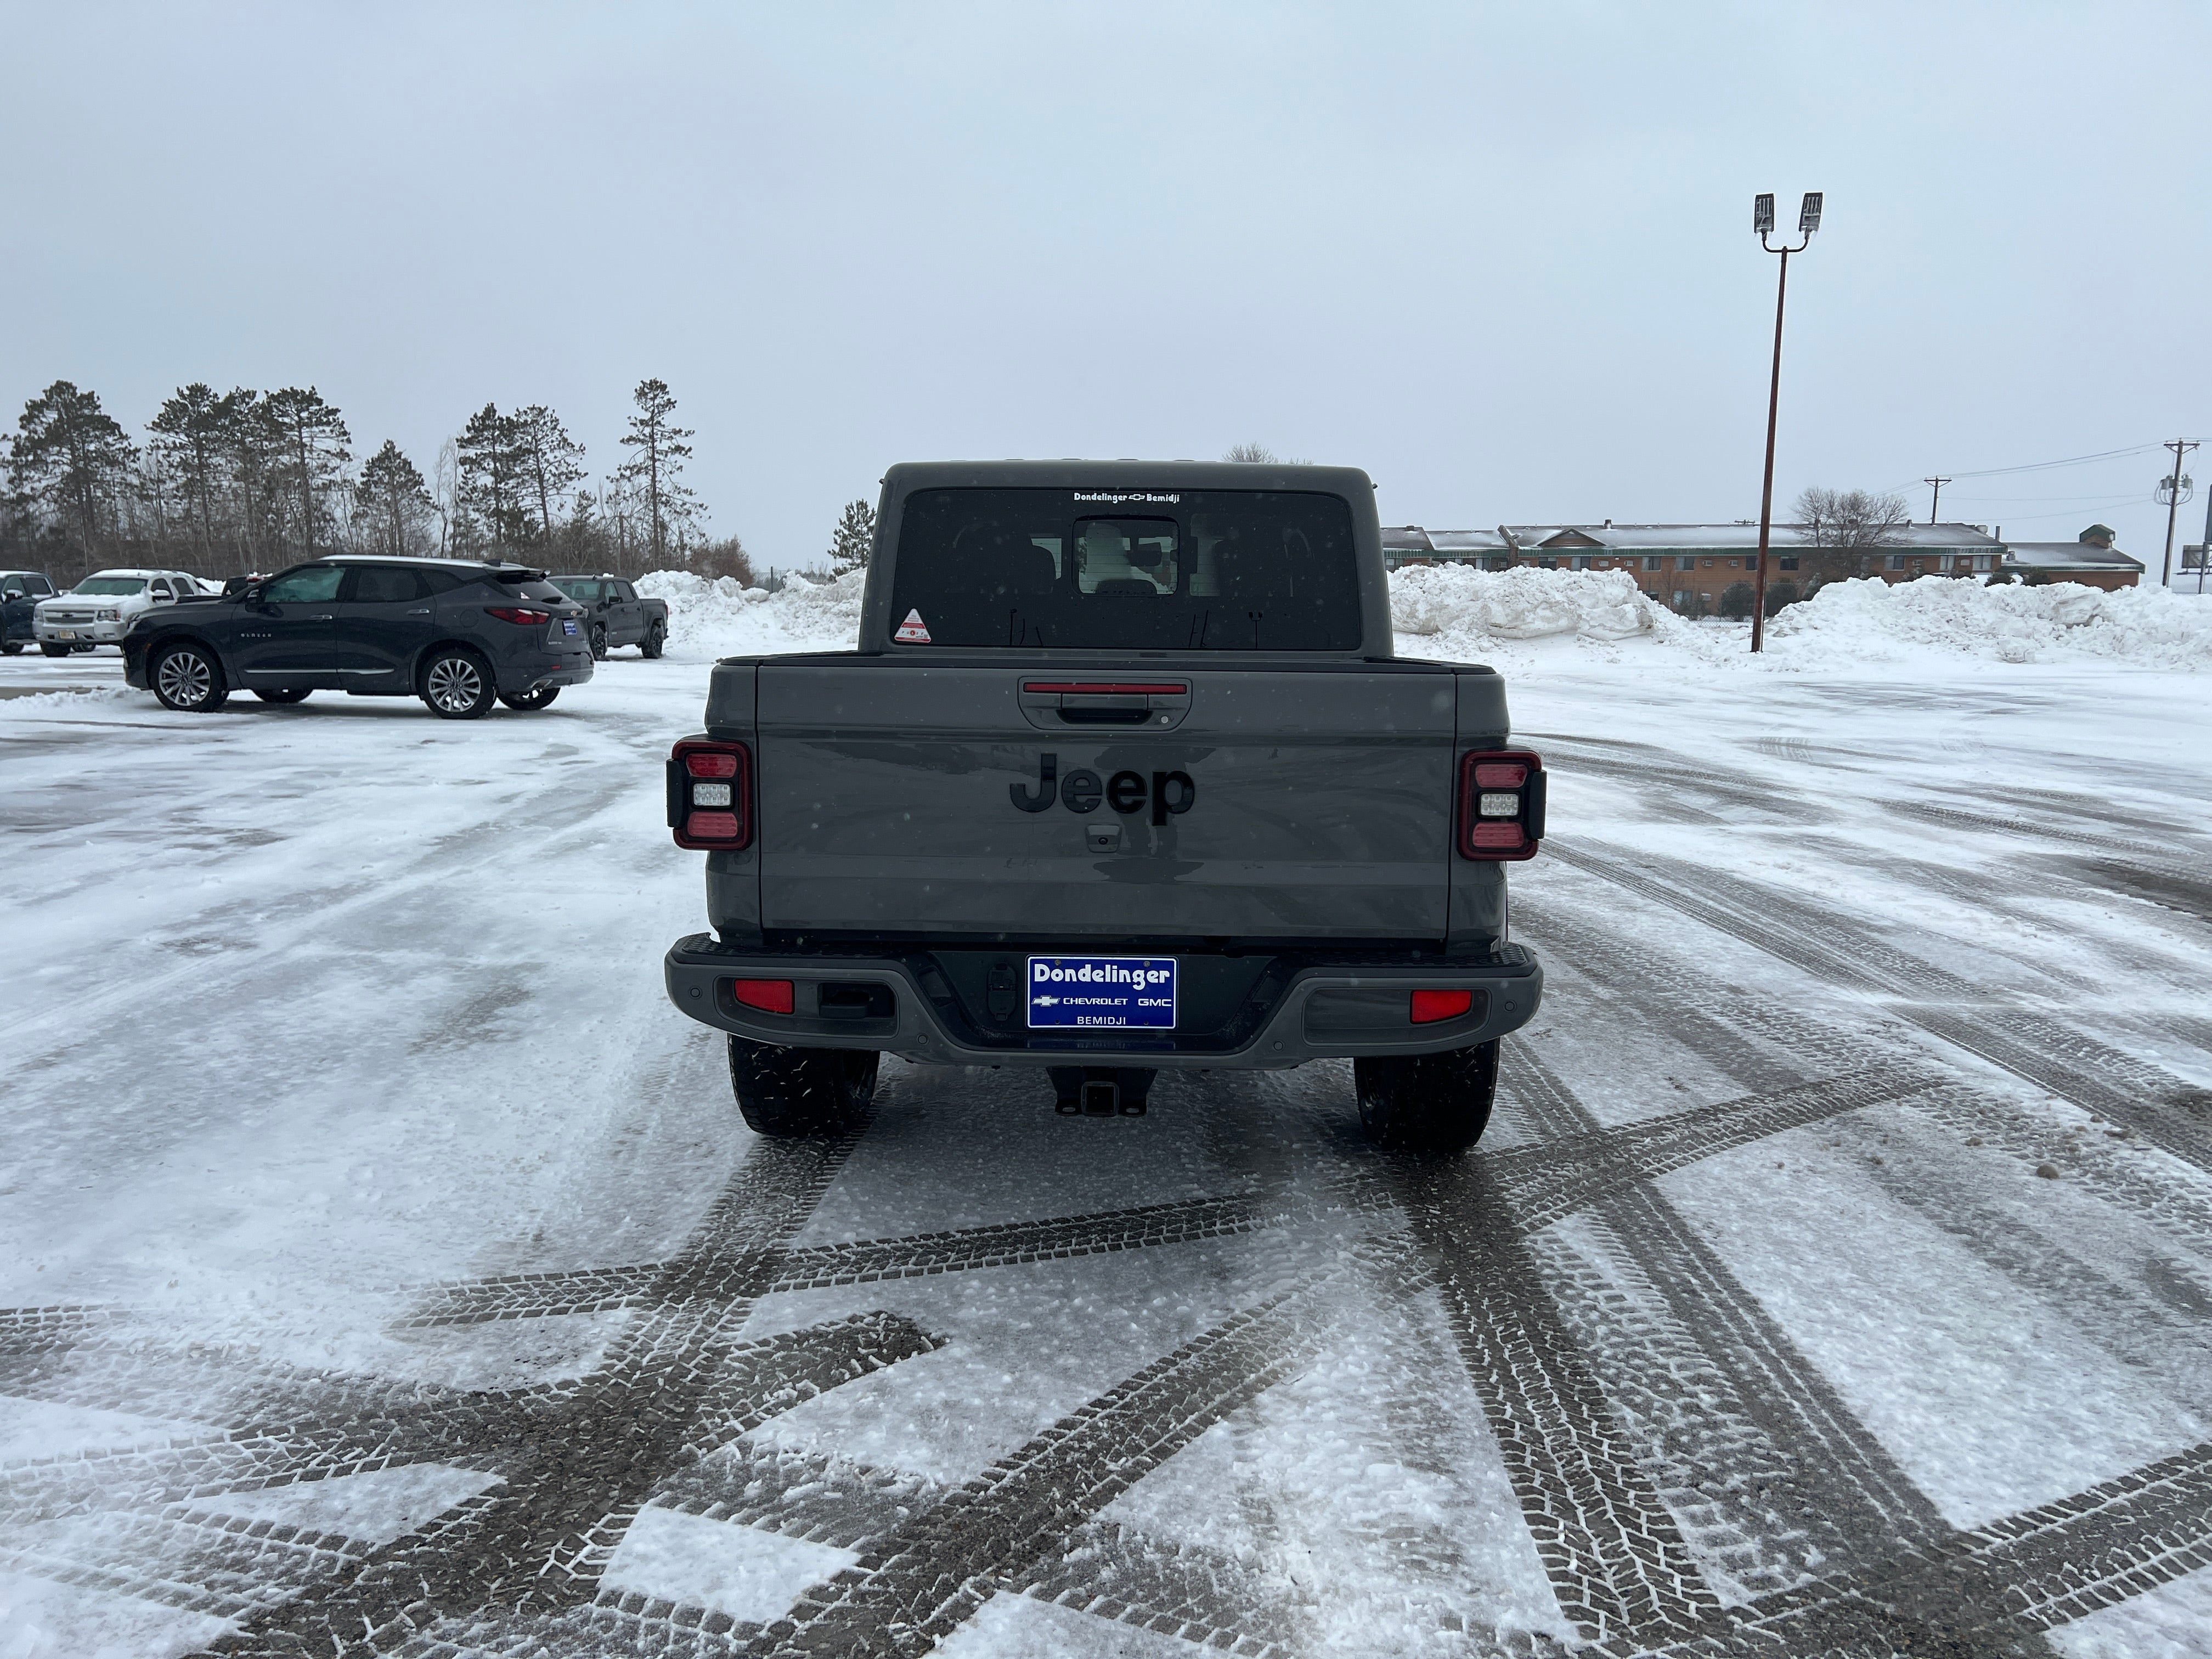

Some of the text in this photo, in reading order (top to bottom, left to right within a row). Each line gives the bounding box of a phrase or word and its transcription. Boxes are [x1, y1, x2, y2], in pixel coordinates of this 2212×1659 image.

[1074, 493, 1180, 504] Dondelinger Bemidji
[1009, 753, 1195, 826] Jeep
[1034, 963, 1170, 990] Dondelinger
[1138, 998, 1172, 1007] GMC
[1077, 1016, 1126, 1025] BEMIDJI
